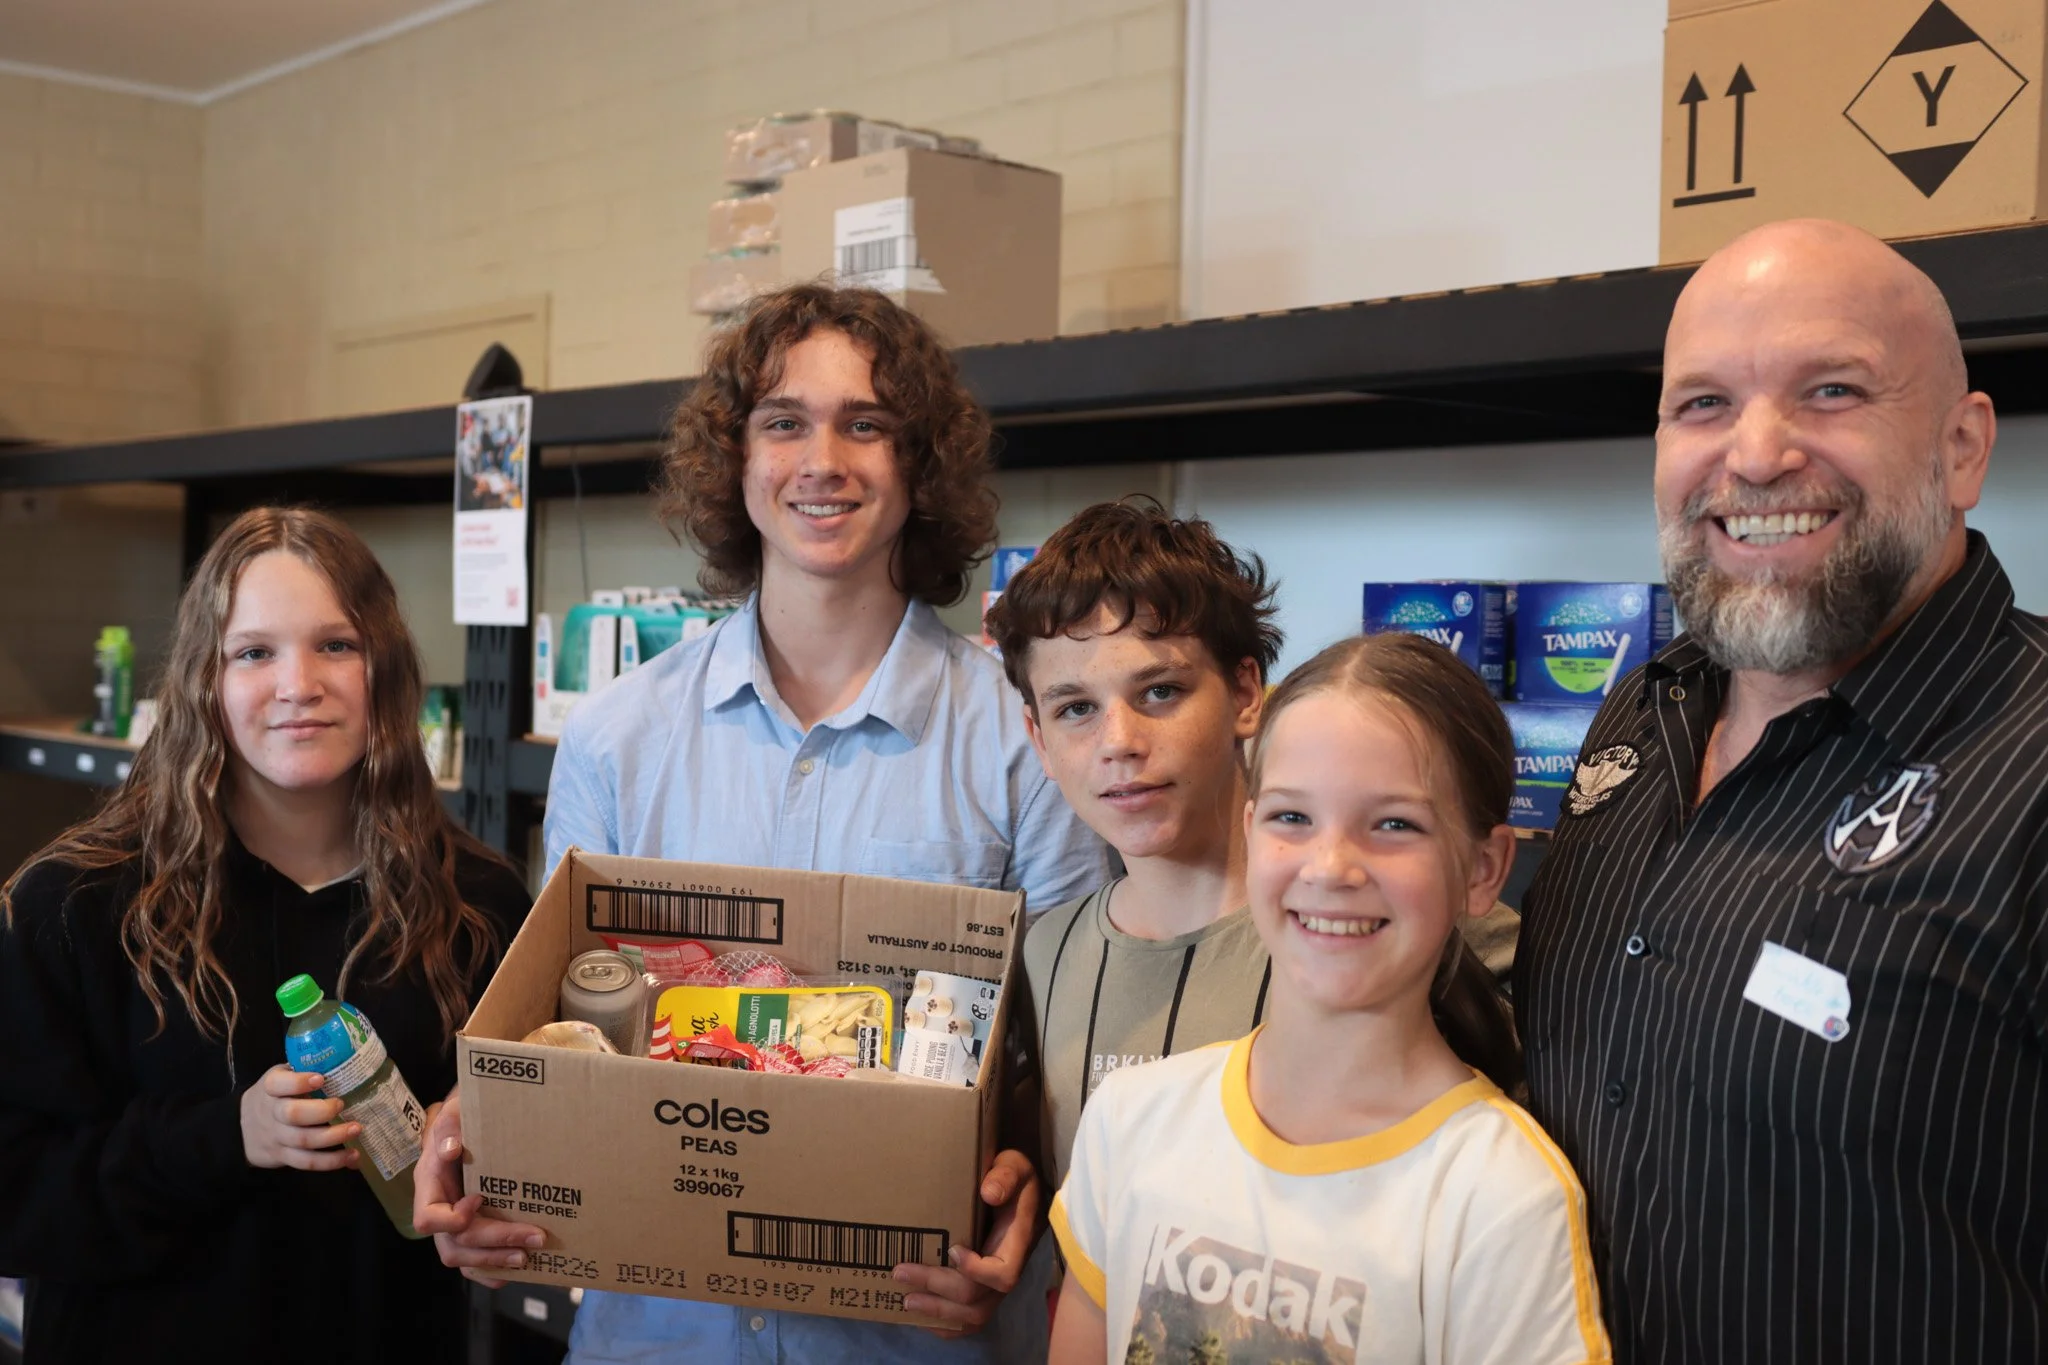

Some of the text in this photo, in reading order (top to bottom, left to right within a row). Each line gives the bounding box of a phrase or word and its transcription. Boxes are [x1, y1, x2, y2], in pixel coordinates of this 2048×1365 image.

[1911, 64, 1957, 128] Y
[1542, 630, 1618, 652] TAMPAX
[1514, 754, 1579, 774] TAMPA
[1588, 745, 1640, 769] VICTORY
[632, 879, 672, 890] 25964
[681, 883, 722, 894] 00601
[731, 887, 753, 897] 193
[966, 922, 1005, 937] EST.86
[867, 934, 1003, 960] PRODUCT OF AUSTRALIA
[837, 961, 871, 975] 3123
[748, 995, 761, 1036] AGNOLOTTI
[473, 1056, 540, 1080] 42656
[923, 1041, 938, 1078] RICE PUDDING
[933, 1042, 948, 1079] VANILLA BEAN
[654, 1098, 770, 1135] coles
[681, 1135, 738, 1156] PEAS
[680, 1164, 740, 1182] 12 x 1kg
[479, 1175, 582, 1207] KEEP FROZEN
[673, 1178, 745, 1199] 399067
[481, 1196, 578, 1219] BEST BEFORE:
[616, 1263, 688, 1289] DEV21
[762, 1260, 895, 1279] 193 00601 2596
[1145, 1223, 1360, 1349] Kodak
